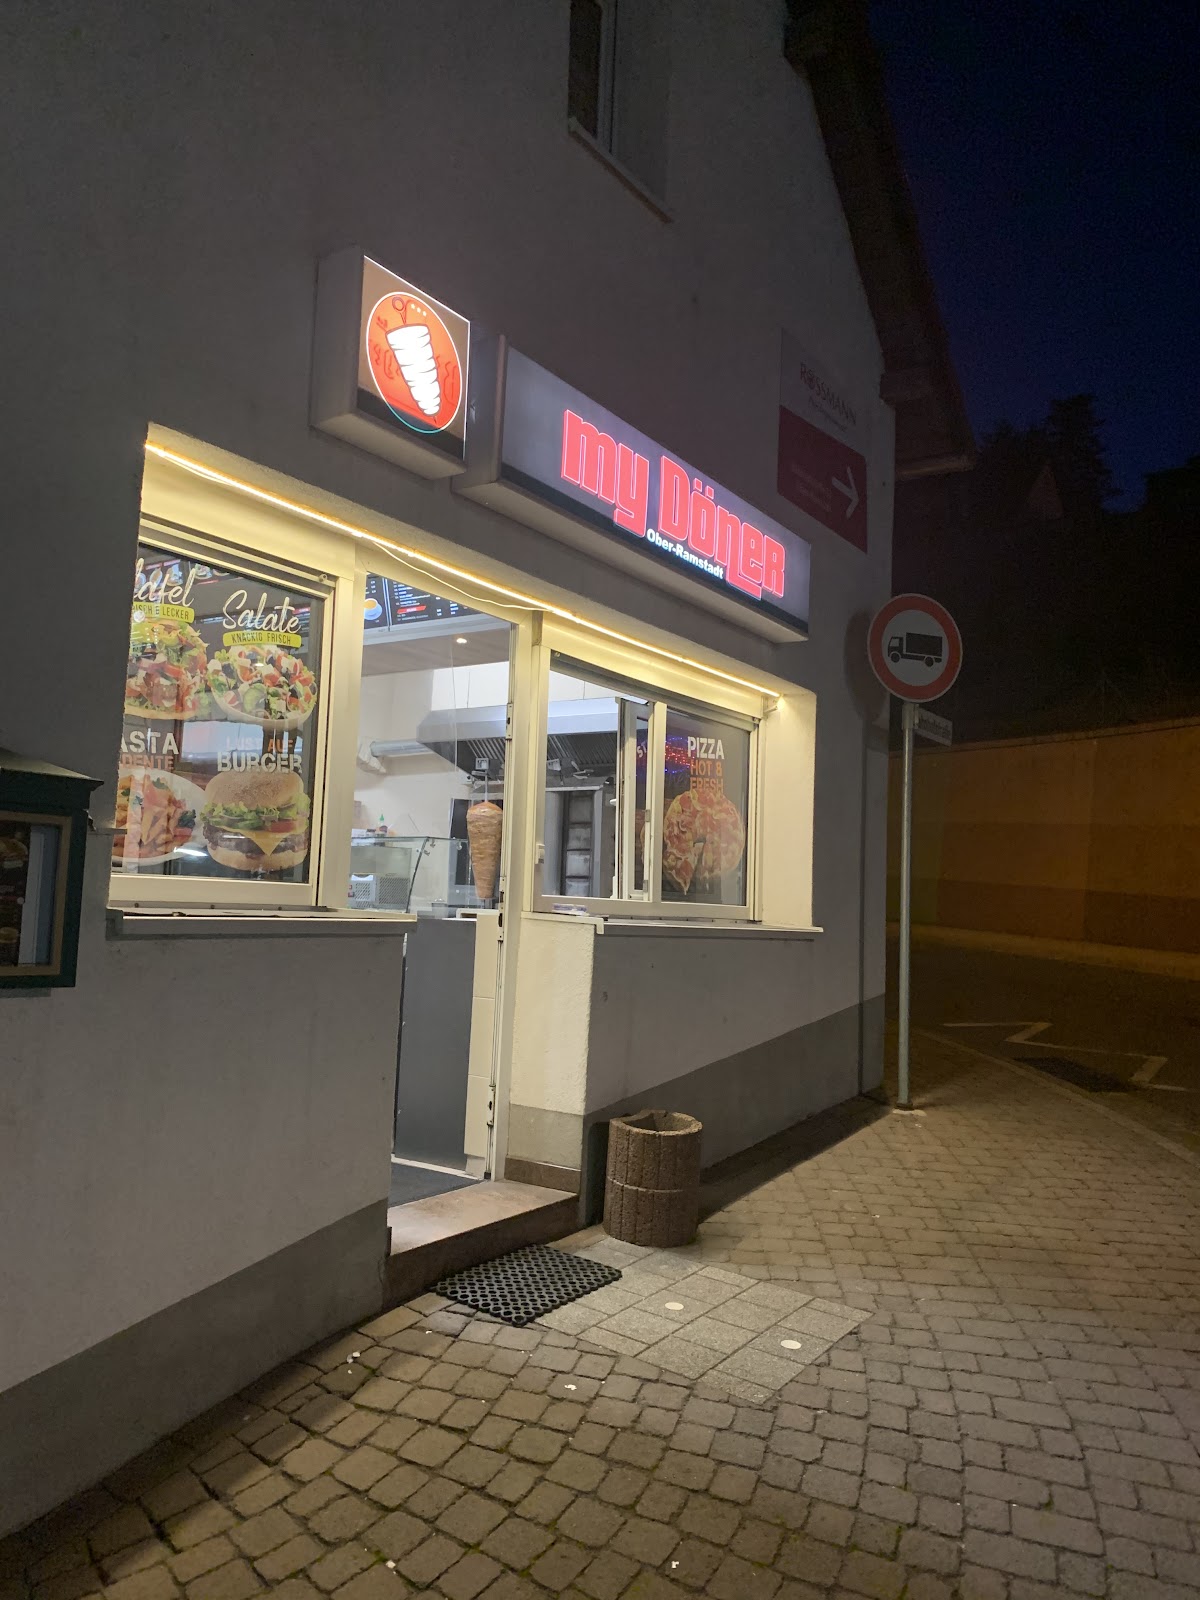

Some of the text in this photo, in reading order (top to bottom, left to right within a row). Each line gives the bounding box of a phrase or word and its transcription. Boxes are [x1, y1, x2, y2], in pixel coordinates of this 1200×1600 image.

[646, 528, 724, 579] Ober-Ramstadt
[162, 606, 189, 620] LECKER
[222, 589, 302, 633] Salate
[266, 632, 291, 645] FRISCH
[687, 736, 725, 760] PIZZA
[217, 752, 303, 773] BURGER
[690, 759, 712, 776] HOT
[690, 777, 723, 793] FRESH
